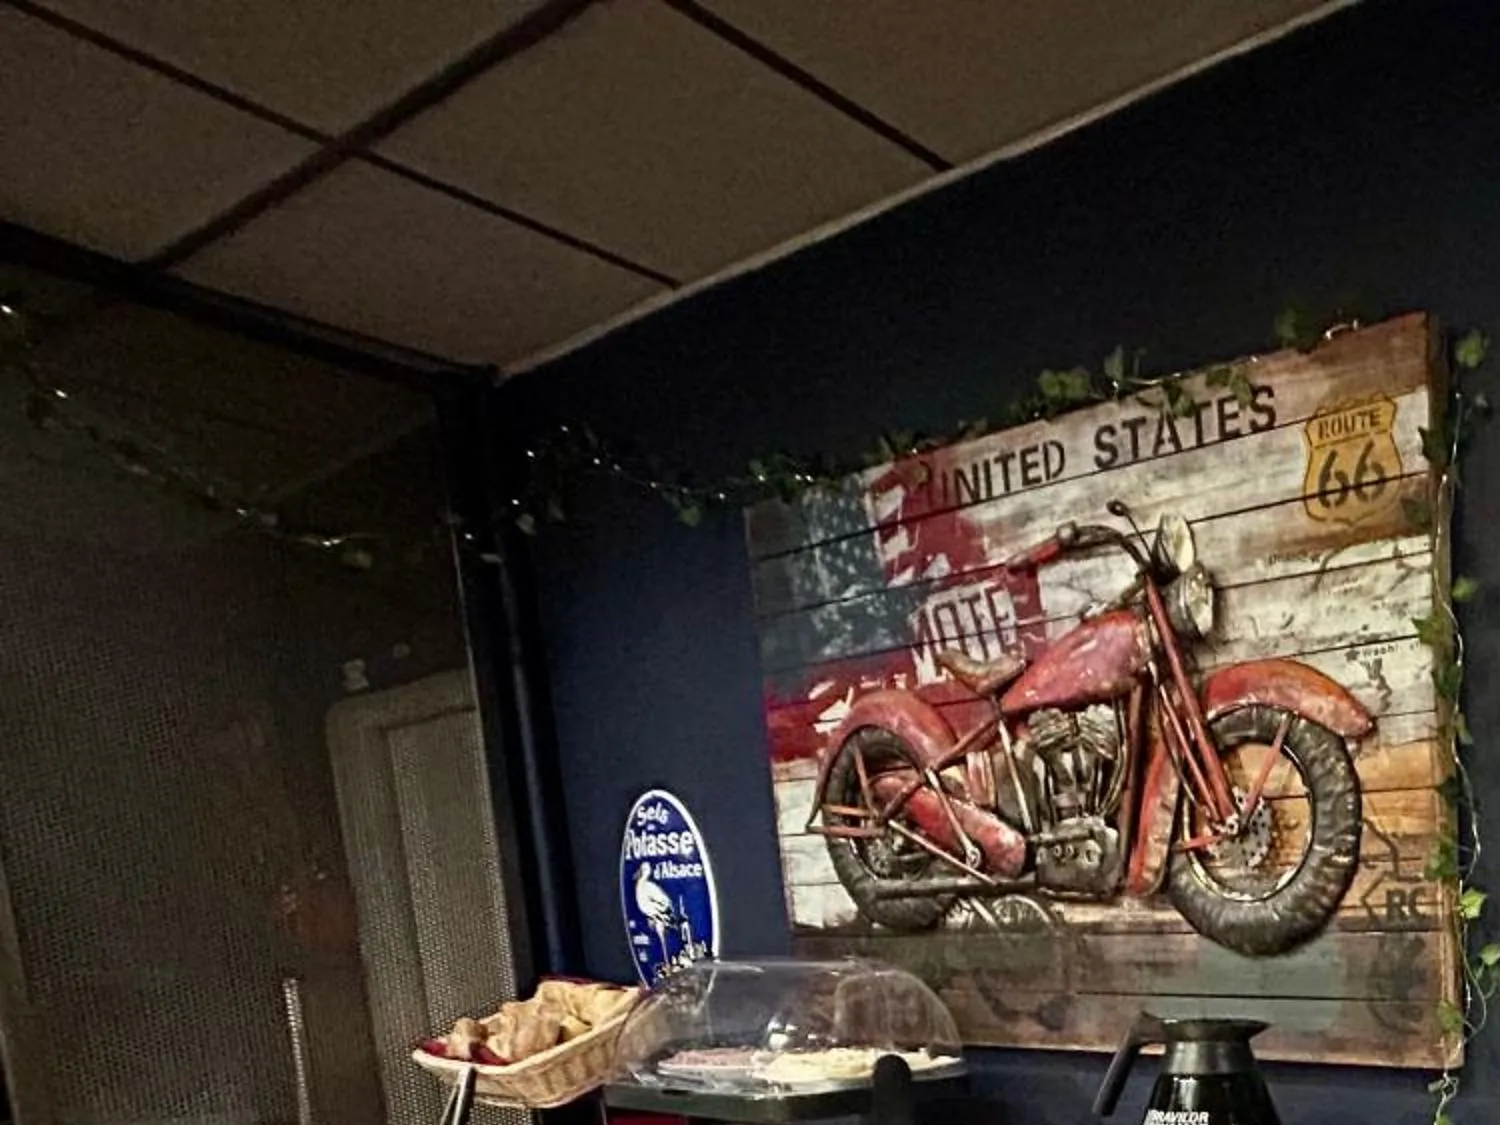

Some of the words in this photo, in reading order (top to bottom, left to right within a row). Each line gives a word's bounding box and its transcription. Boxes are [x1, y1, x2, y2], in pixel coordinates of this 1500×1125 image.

[1318, 407, 1381, 440] ROUTE
[927, 441, 1066, 506] UNITED
[1093, 385, 1278, 470] STATES
[1318, 440, 1385, 508] 66
[637, 802, 669, 827] Sels
[624, 829, 695, 860] Potasse
